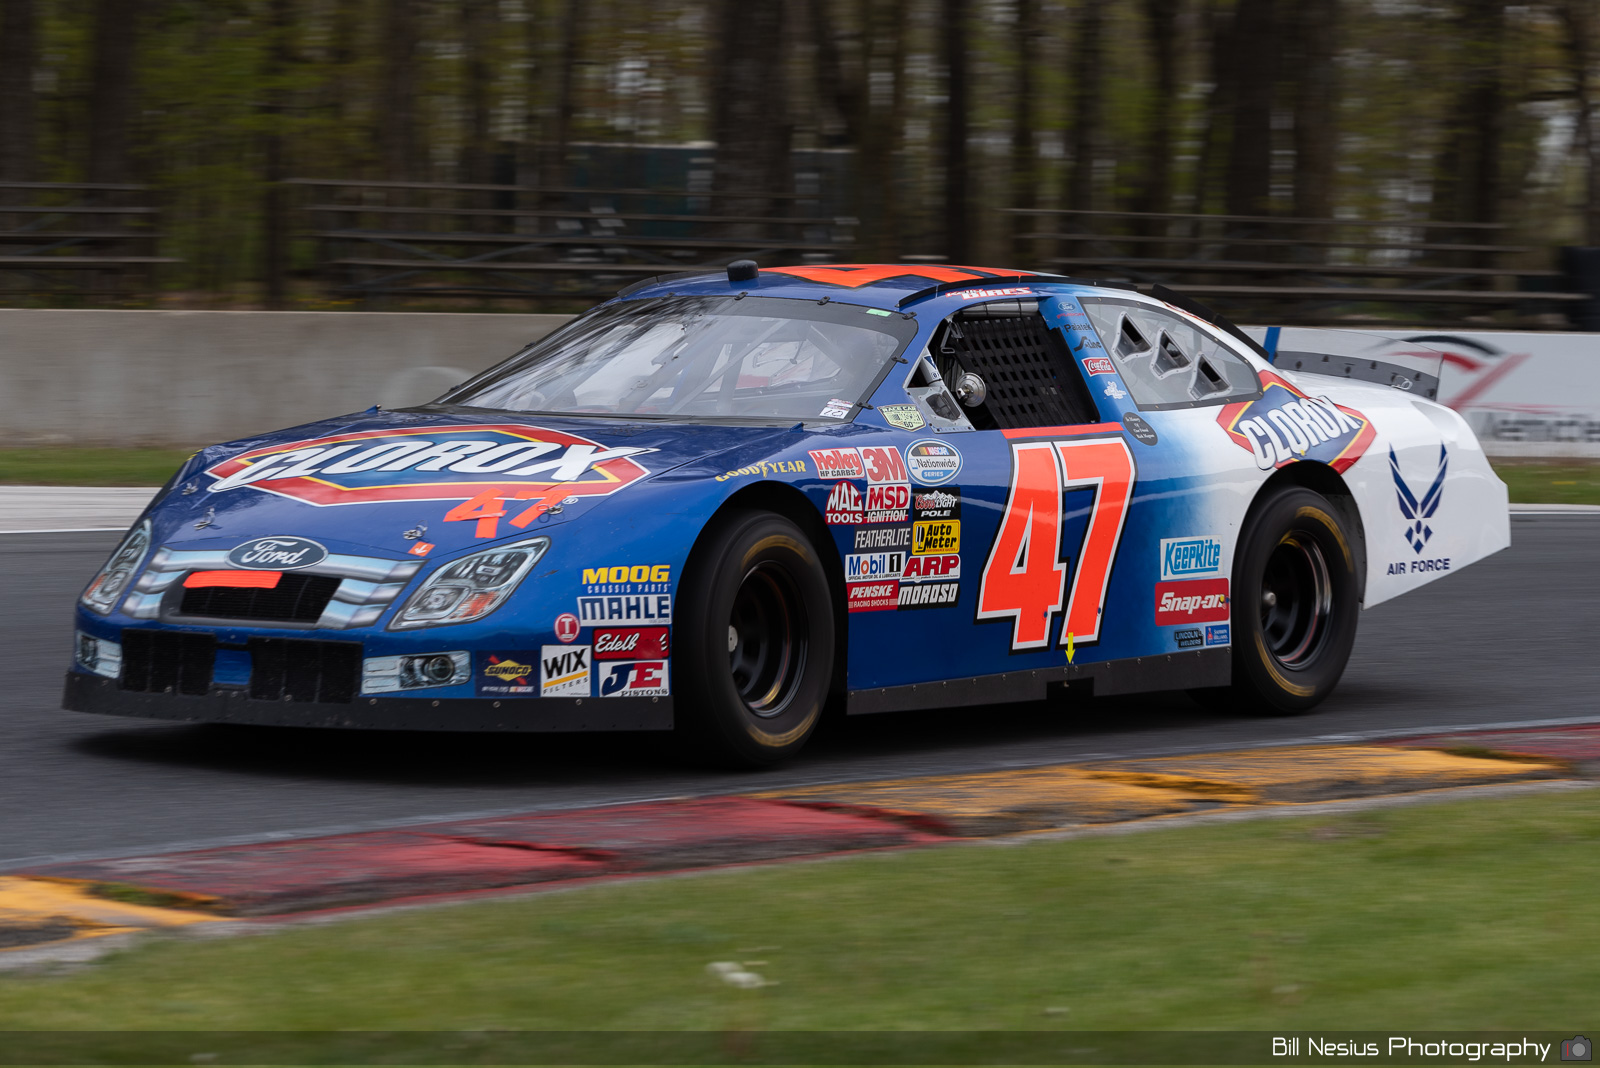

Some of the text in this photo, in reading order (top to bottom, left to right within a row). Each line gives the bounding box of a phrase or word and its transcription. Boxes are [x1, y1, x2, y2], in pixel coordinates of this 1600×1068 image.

[1239, 395, 1363, 471] CLOROX
[927, 446, 950, 456] NASCAR
[207, 440, 661, 492] CLOROX
[811, 449, 863, 475] Holley
[862, 447, 907, 482] 3M
[917, 458, 957, 468] Nationwide
[831, 469, 856, 477] CARBS
[828, 483, 863, 512] MAC
[868, 486, 909, 510] MSD
[915, 494, 957, 510] Coors LIGHT
[443, 487, 573, 539] 47
[826, 512, 863, 524] TOOLS
[867, 510, 907, 523] IGNITION
[921, 509, 951, 518] POLE
[855, 527, 911, 549] FEATHERLITE
[926, 523, 952, 537] Auto
[241, 540, 303, 565] Ford
[925, 536, 957, 550] Meter
[976, 436, 1136, 652] 47
[582, 564, 671, 585] MOOG
[848, 554, 898, 576] Mobil 1
[902, 555, 960, 578] ARP
[1387, 558, 1451, 576] AIR FORCE
[588, 584, 669, 594] CHASSIS PARTS
[850, 584, 894, 599] PENSKE
[897, 583, 959, 606] MOROSO
[580, 596, 670, 620] MAHLE
[1158, 591, 1224, 615] Snap-on
[1175, 630, 1199, 640] LINCOLN
[487, 666, 529, 675] SUNOCO
[543, 647, 588, 680] WIX
[543, 678, 588, 694] FILTERS
[602, 662, 664, 696] JE
[620, 688, 668, 697] PISTONS
